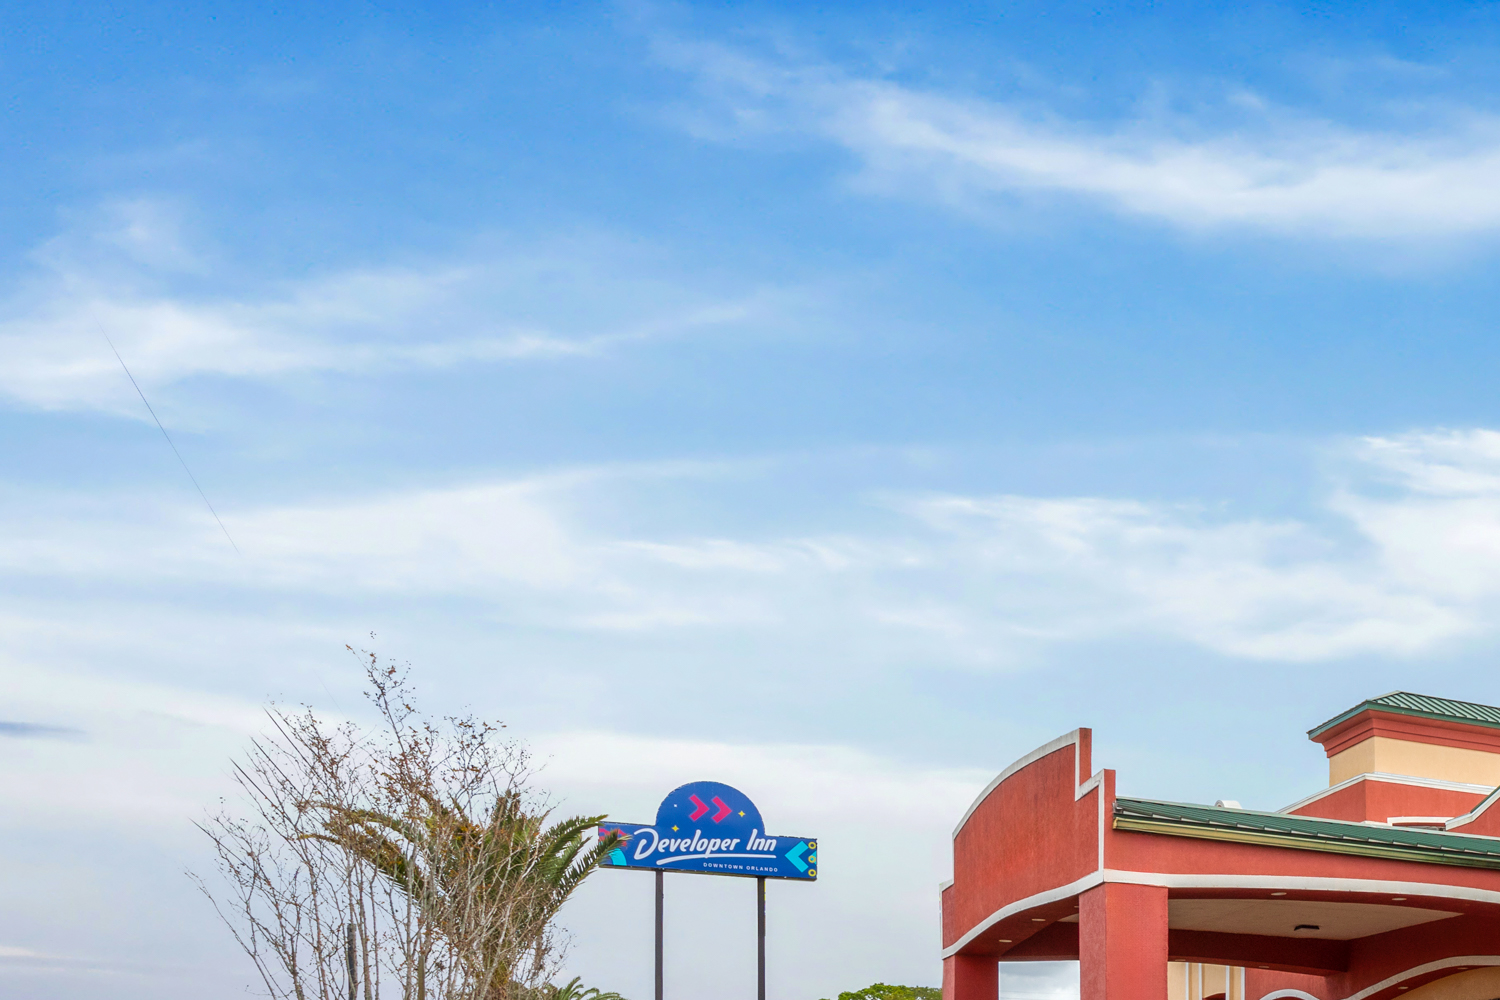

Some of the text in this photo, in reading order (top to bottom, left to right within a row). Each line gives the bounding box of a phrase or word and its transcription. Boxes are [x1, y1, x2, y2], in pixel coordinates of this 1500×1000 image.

[633, 827, 777, 861] Developer Inn
[703, 862, 778, 873] DOWNTOWN ORLANDO
